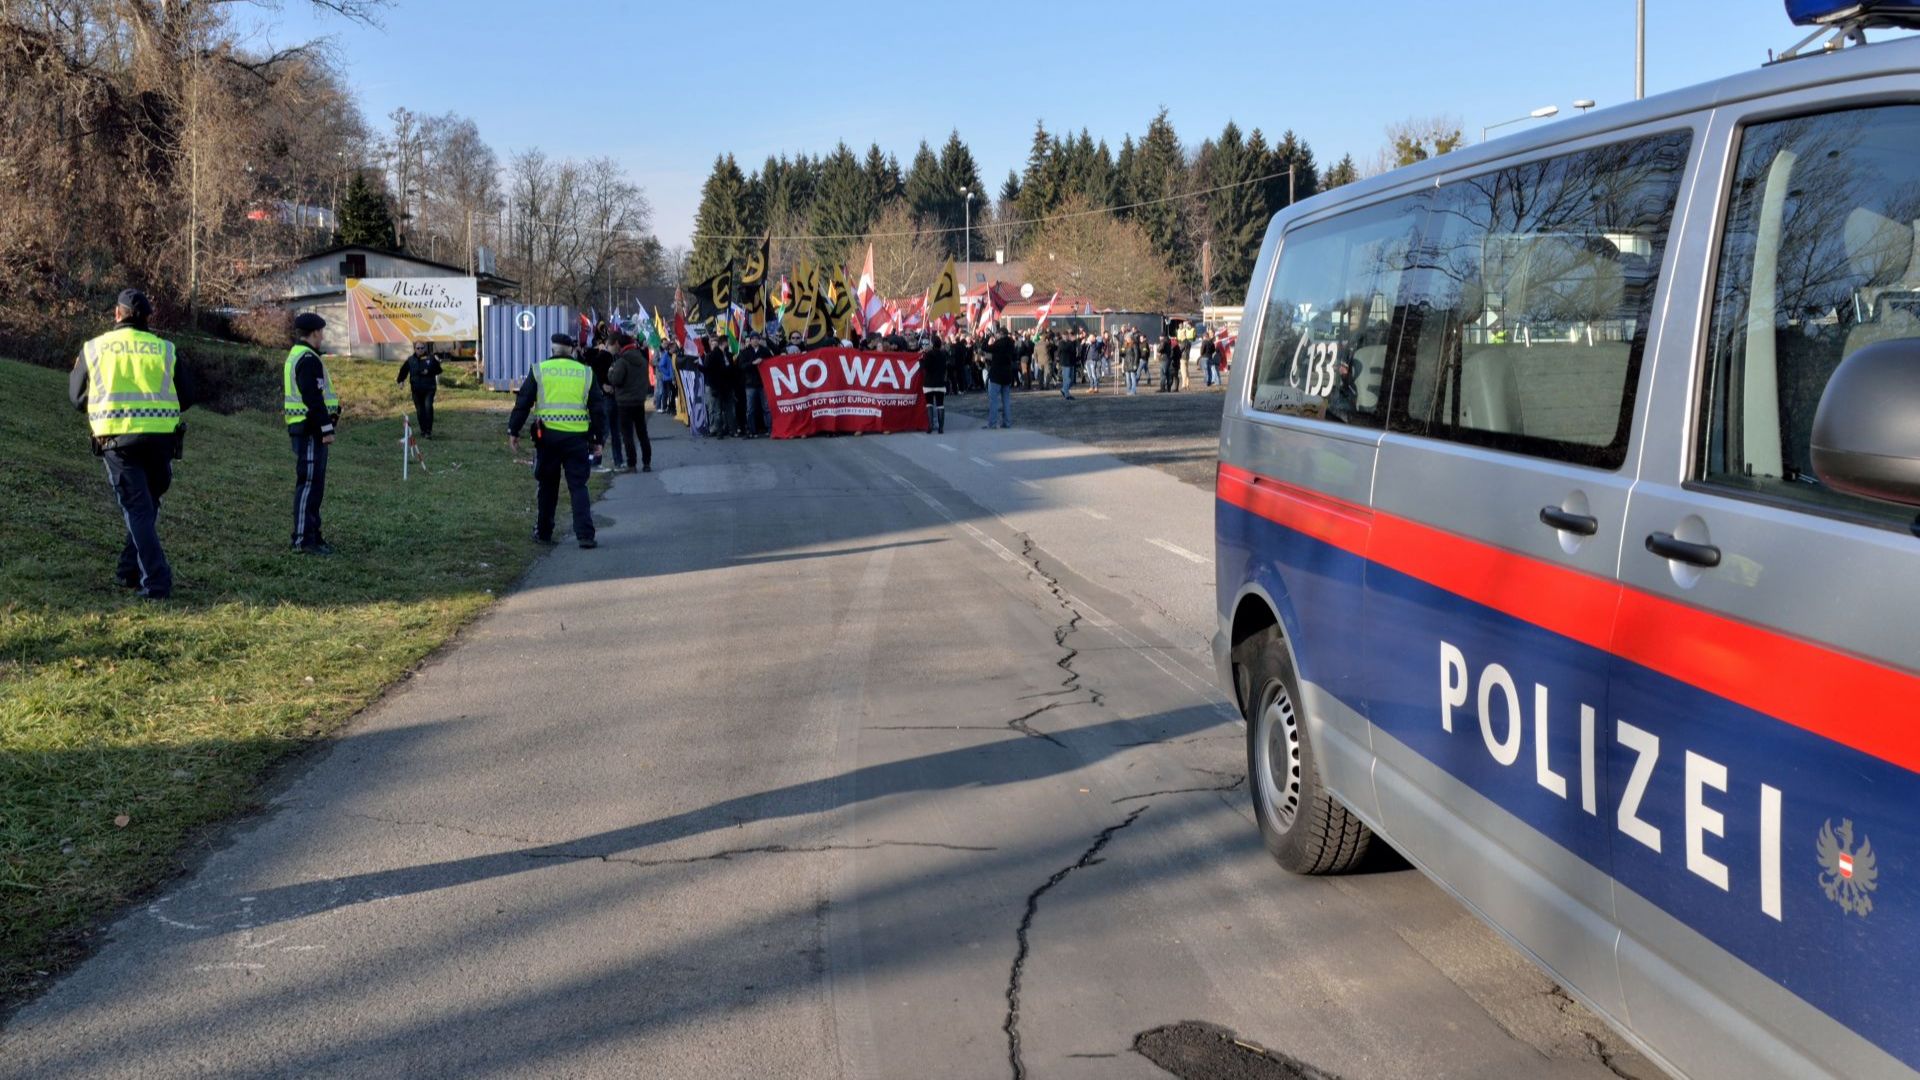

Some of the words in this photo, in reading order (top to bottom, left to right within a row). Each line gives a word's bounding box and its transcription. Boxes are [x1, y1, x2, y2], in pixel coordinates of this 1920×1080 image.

[366, 293, 463, 310] Sonnenstudio
[100, 340, 162, 355] POLIZEI
[541, 367, 585, 378] POLIZEI
[769, 358, 828, 396] NO
[838, 355, 921, 390] WAY
[1305, 342, 1338, 397] 133
[795, 401, 811, 411] WILL
[812, 398, 827, 406] NOT
[828, 396, 846, 404] MAKE
[847, 395, 876, 405] EUROPE
[1440, 640, 1782, 922] POLIZEI
